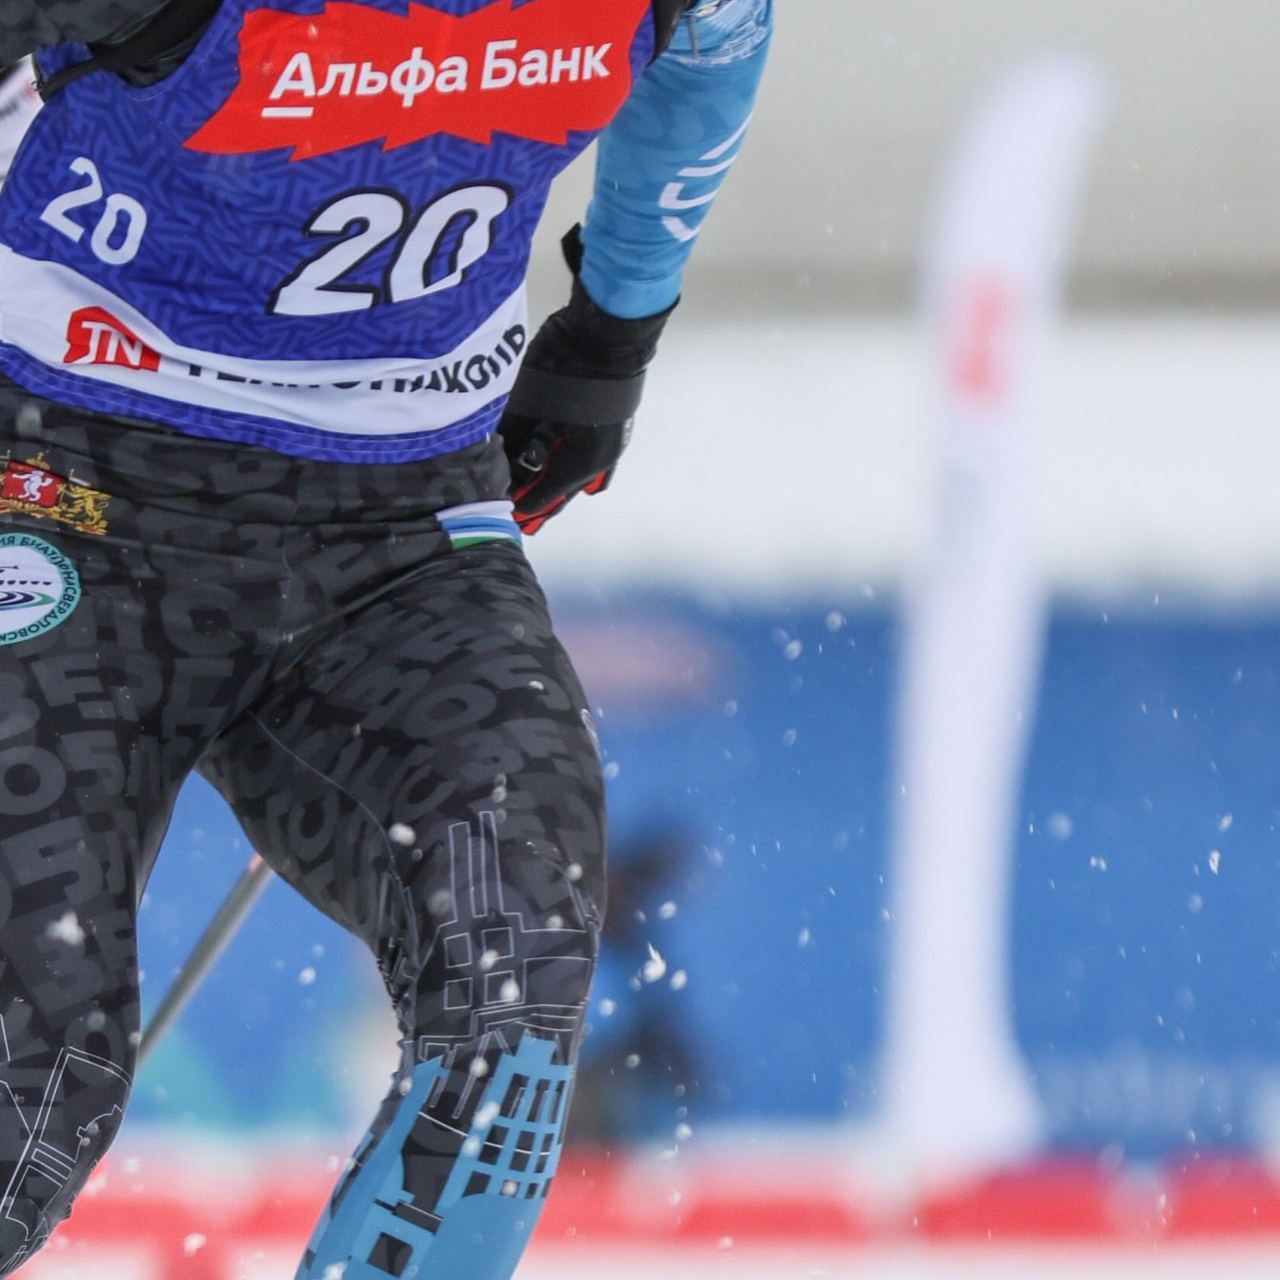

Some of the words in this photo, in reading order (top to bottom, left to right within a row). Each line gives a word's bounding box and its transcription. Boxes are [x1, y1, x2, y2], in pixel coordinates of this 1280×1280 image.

[269, 46, 468, 108] Альфа
[480, 38, 613, 91] Банк
[39, 156, 148, 266] 20
[267, 178, 516, 317] 20
